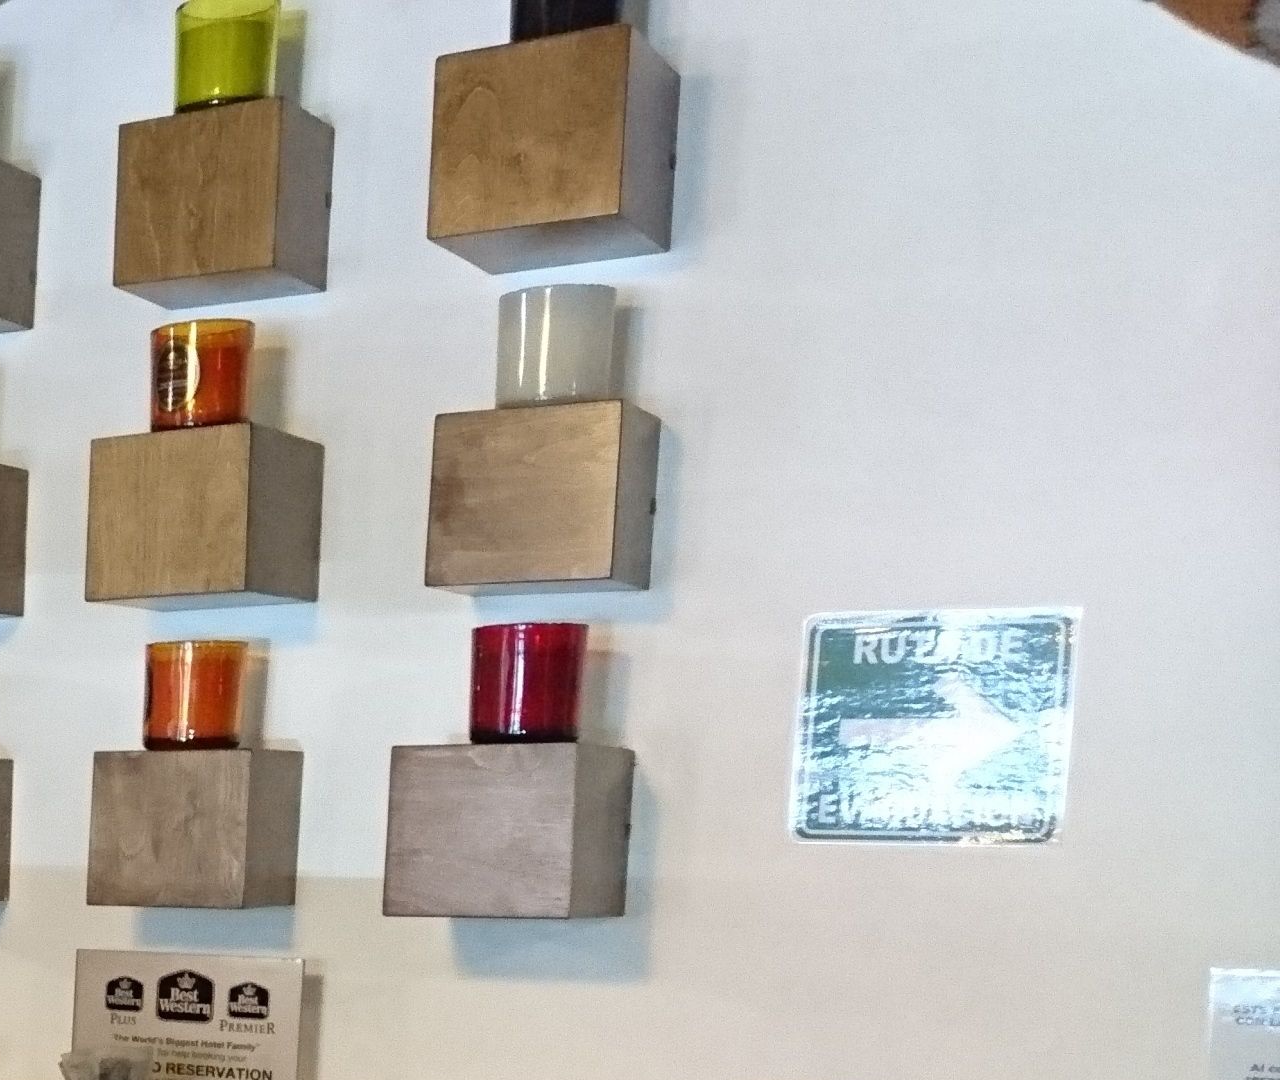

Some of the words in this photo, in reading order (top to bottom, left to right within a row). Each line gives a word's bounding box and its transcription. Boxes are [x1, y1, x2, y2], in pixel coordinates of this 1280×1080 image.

[170, 987, 199, 1002] Best
[159, 999, 211, 1015] Western
[228, 1002, 268, 1015] Western
[110, 1012, 137, 1025] PLUS
[219, 1019, 276, 1035] PREMIER
[132, 1035, 164, 1044] World's
[165, 1037, 199, 1048] Biggest
[201, 1039, 225, 1049] Hotel
